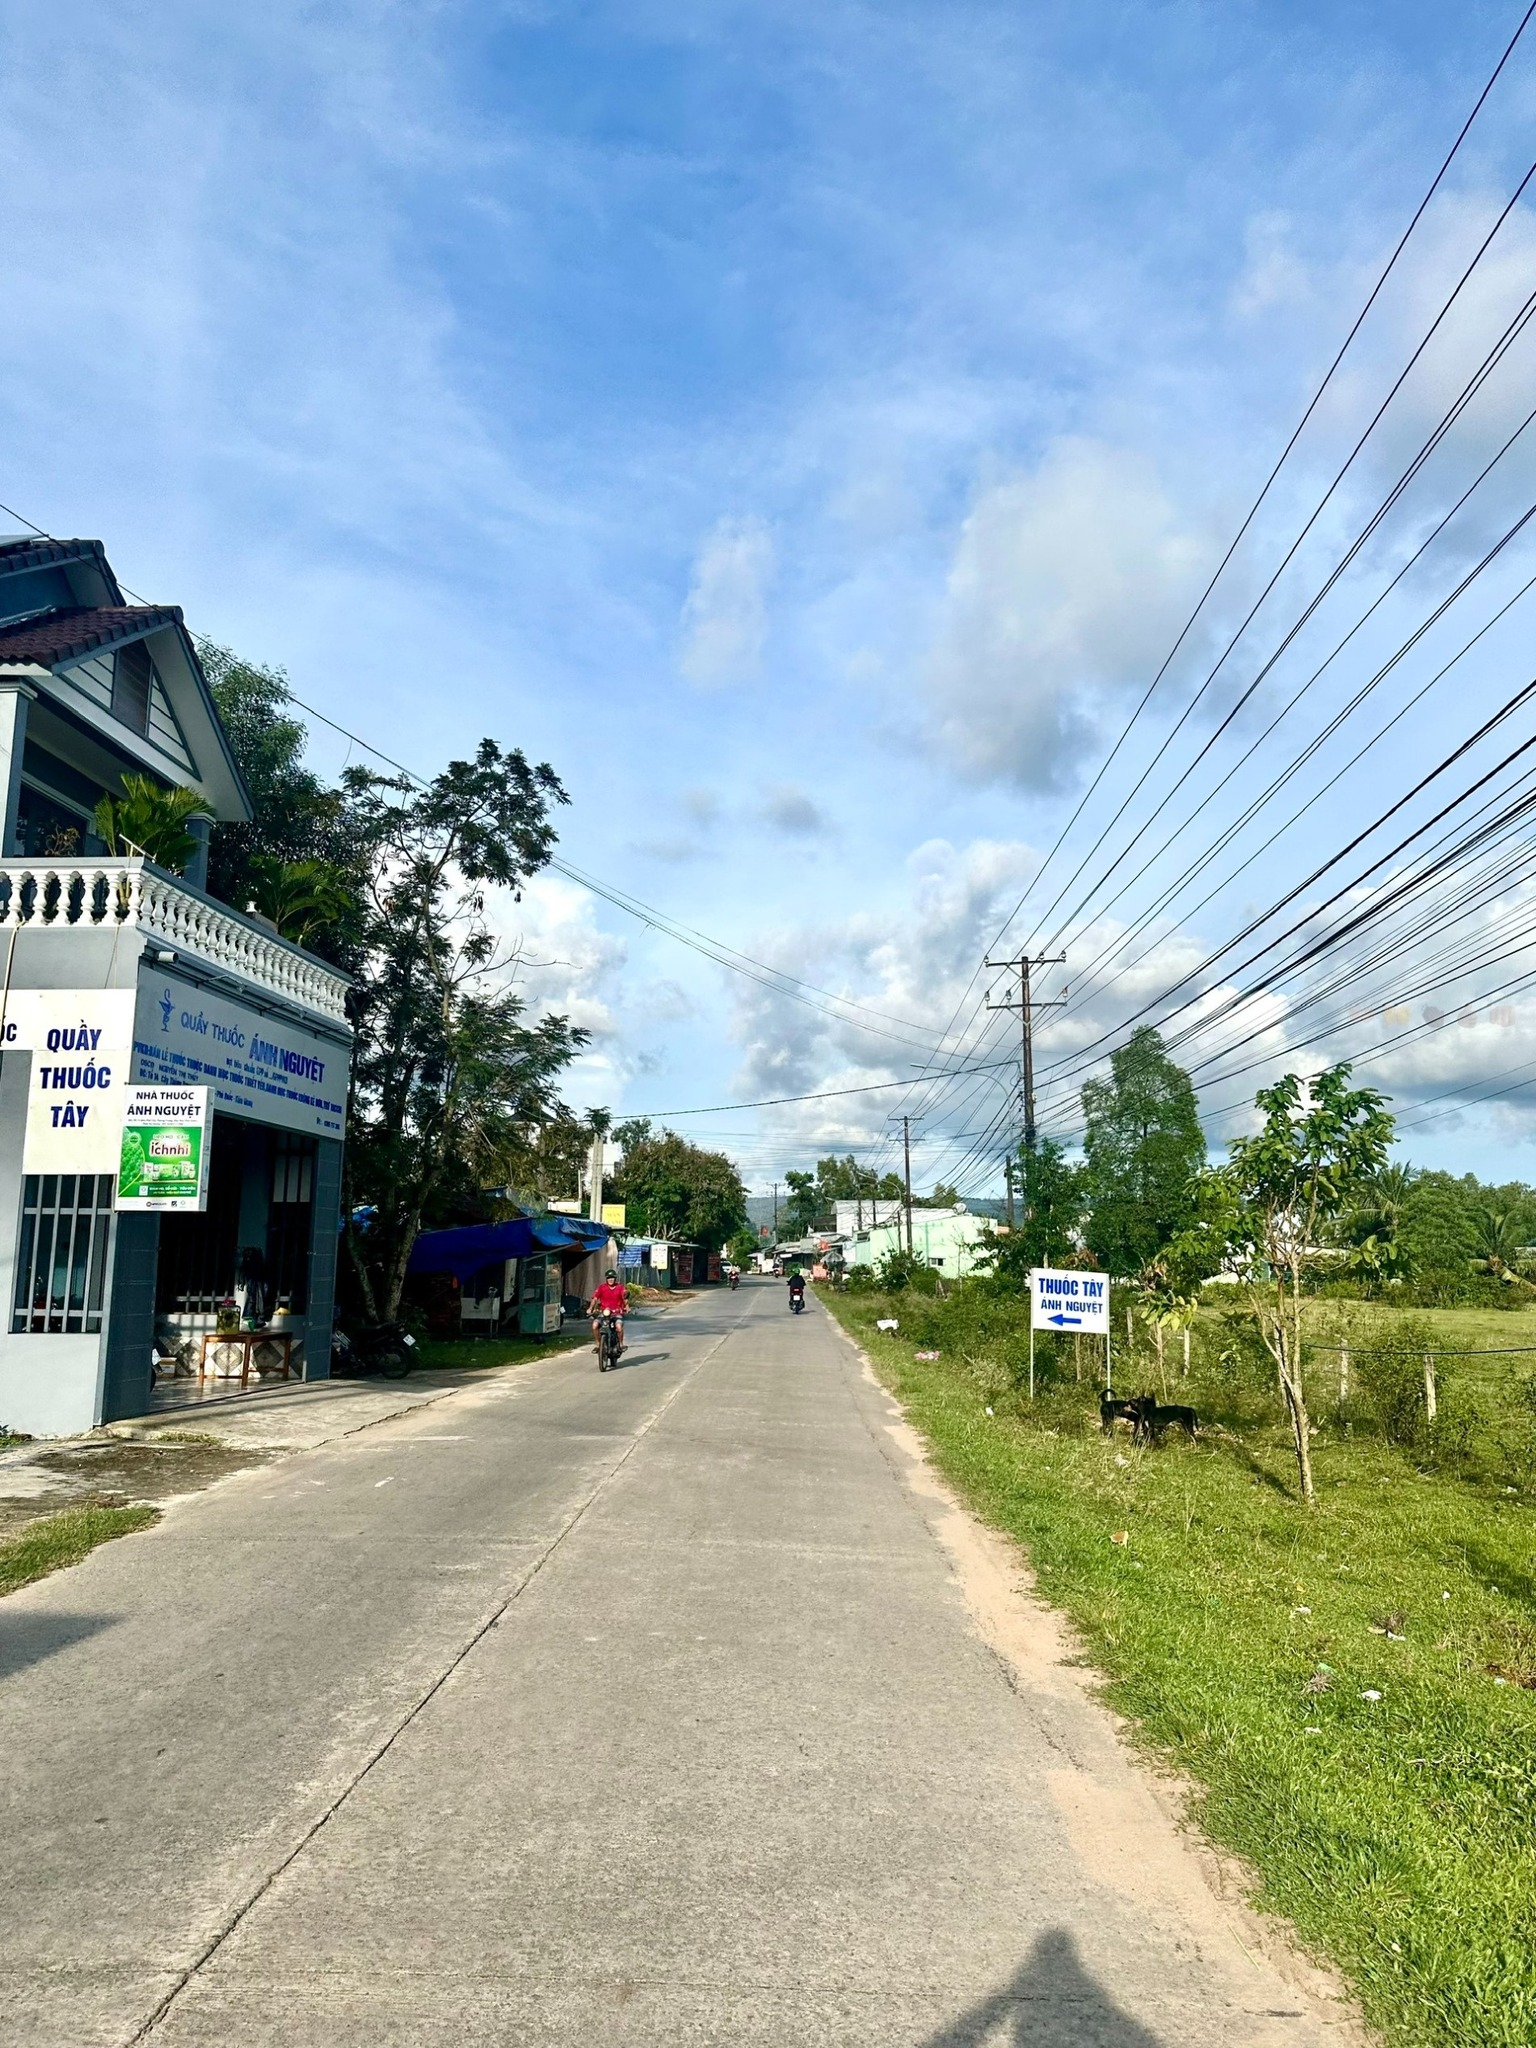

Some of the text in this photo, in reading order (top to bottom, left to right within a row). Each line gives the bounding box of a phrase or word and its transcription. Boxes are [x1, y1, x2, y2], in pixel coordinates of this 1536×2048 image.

[47, 1019, 102, 1052] QUẦY
[212, 1024, 245, 1048] THUỐC
[249, 1034, 278, 1067] ÁNH
[279, 1048, 325, 1084] NGUYỆT
[40, 1057, 111, 1089] THUỐC
[137, 1089, 194, 1099] NHÀ THUỐC
[51, 1100, 89, 1127] TÂY
[127, 1104, 201, 1118] ÁNH NGUYỆT
[1039, 1274, 1103, 1297] THUỐC TÂY
[1041, 1296, 1103, 1315] ÁNH NGUYỆT
